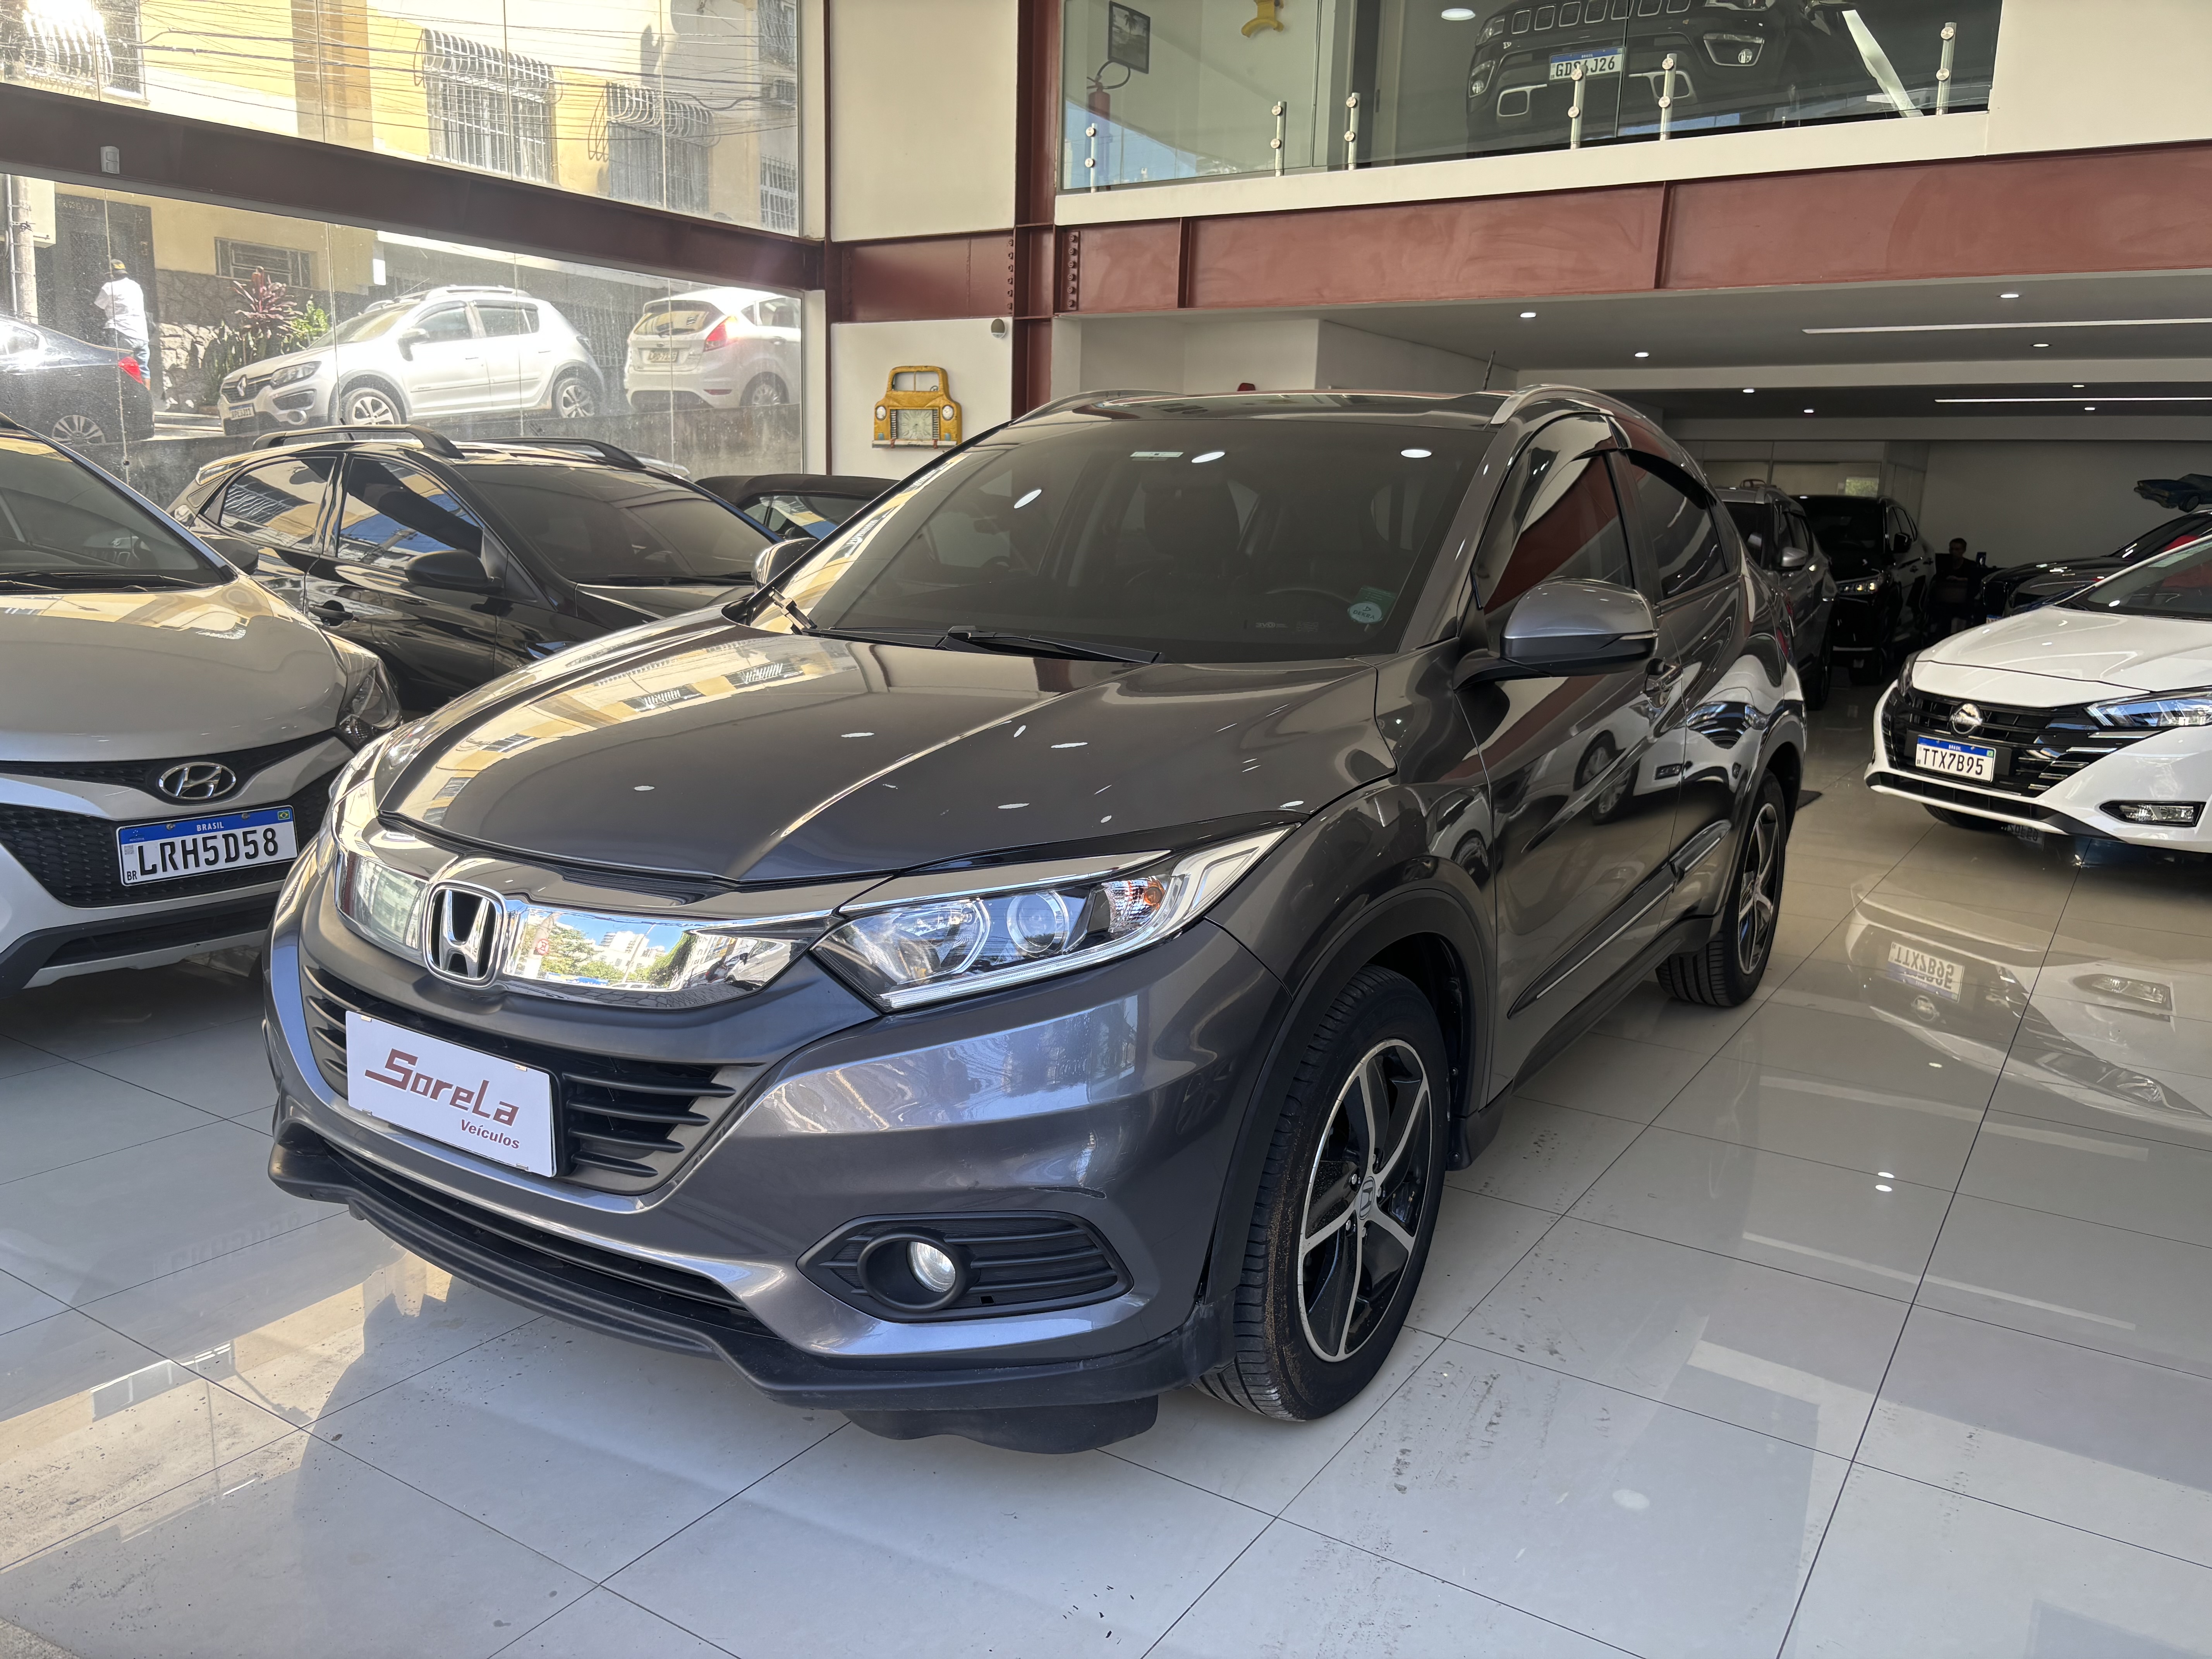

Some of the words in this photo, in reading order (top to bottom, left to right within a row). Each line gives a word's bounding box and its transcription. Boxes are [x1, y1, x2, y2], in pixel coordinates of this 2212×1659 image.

[1353, 610, 1375, 620] DEKRA
[1923, 748, 1984, 775] TTX7B95
[197, 821, 224, 832] BRASIL
[138, 828, 278, 876] LRH5D58
[127, 870, 137, 881] BR
[461, 1119, 520, 1149] Veículos
